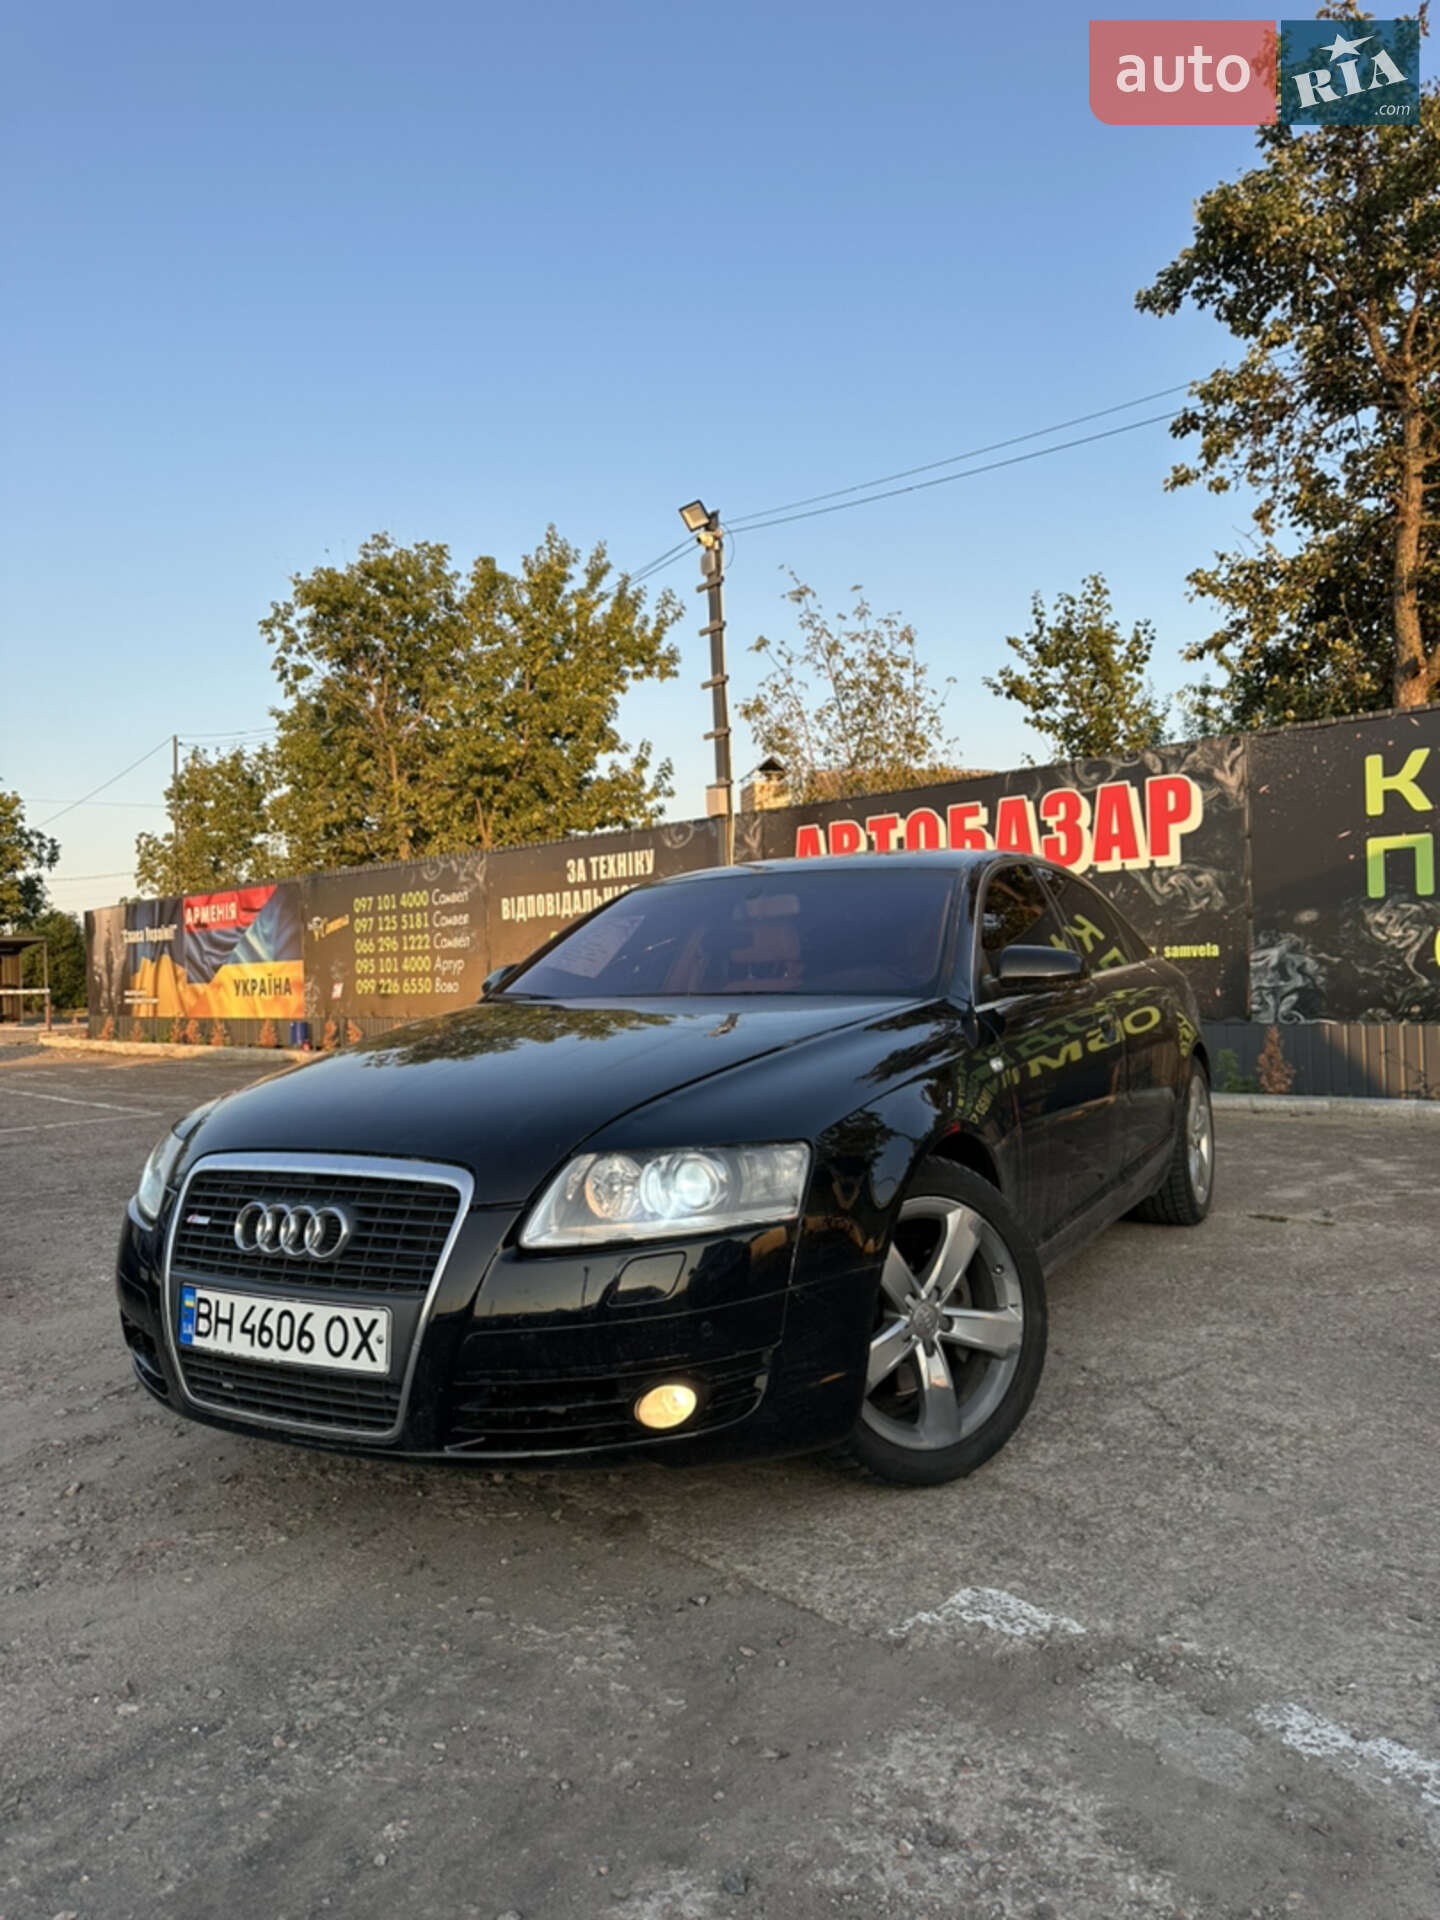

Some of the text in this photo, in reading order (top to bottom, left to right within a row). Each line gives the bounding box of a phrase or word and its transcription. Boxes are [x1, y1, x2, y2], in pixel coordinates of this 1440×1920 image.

[566, 848, 655, 883] ЗА ТЕХНІКУ
[353, 896, 374, 913] 097
[377, 894, 396, 911] 101
[400, 890, 429, 908] 4000
[501, 883, 641, 923] ВІДПОВІДАЛЬН
[185, 902, 237, 925] АРМЕНІЯ
[353, 917, 374, 934] 097
[378, 915, 398, 932] 125
[401, 912, 429, 930] 5181
[354, 938, 375, 954] 066
[402, 934, 430, 951] 1222
[355, 958, 375, 974] 095
[379, 957, 398, 973] 101
[402, 955, 431, 973] 4000
[233, 973, 292, 999] УКРАЇНА
[355, 978, 376, 995] 099
[402, 976, 432, 994] 6550
[194, 1296, 379, 1362] BH 4606 OX
